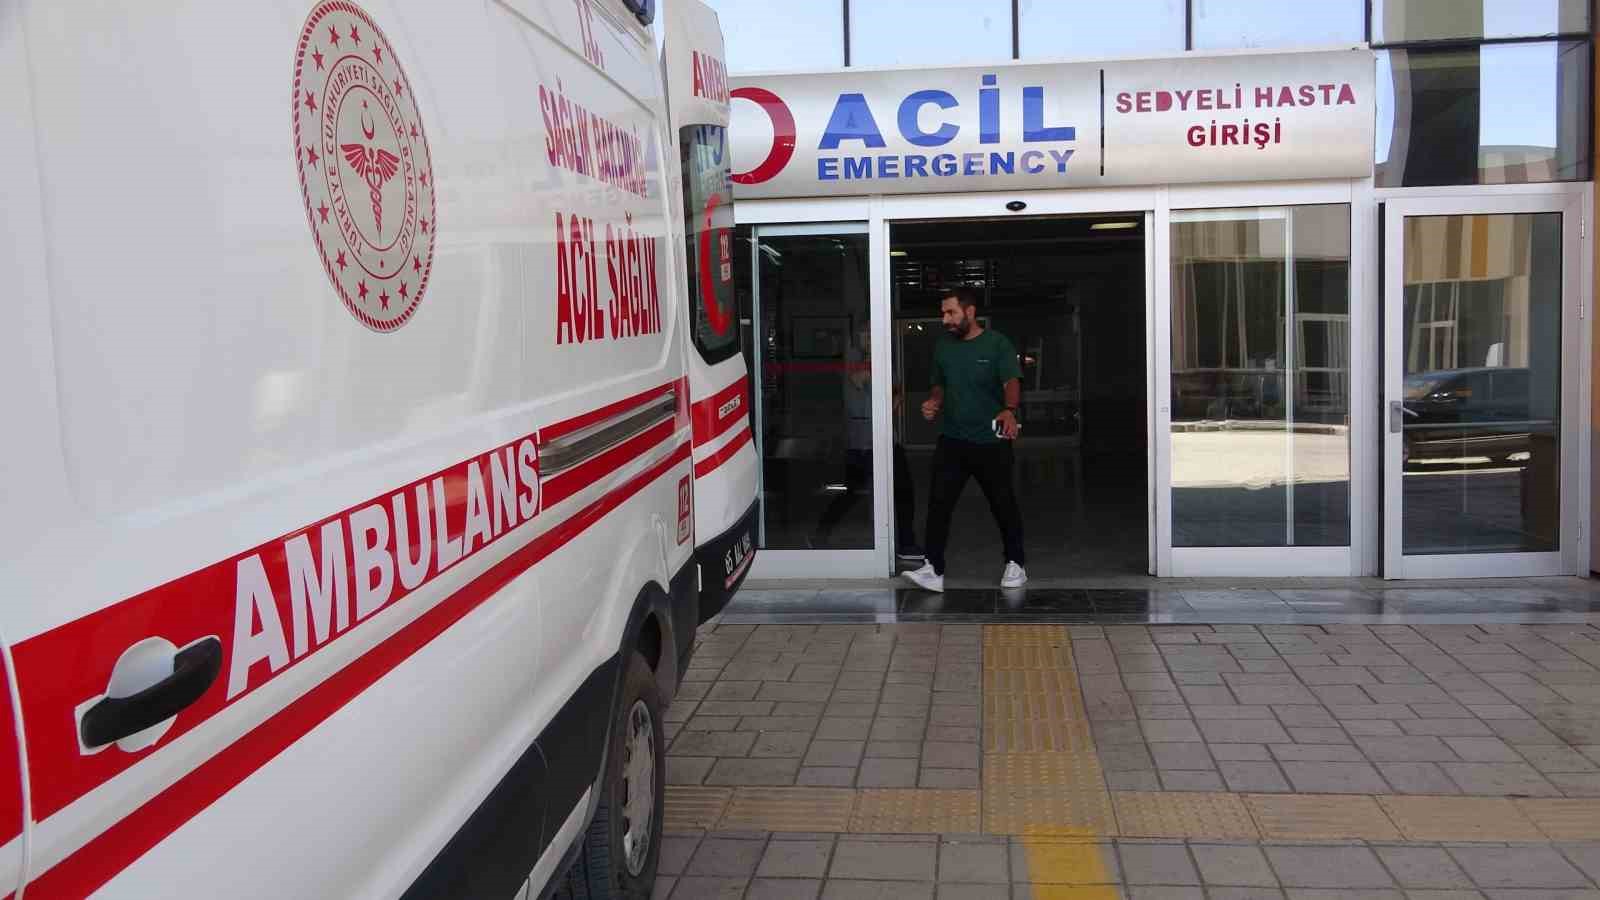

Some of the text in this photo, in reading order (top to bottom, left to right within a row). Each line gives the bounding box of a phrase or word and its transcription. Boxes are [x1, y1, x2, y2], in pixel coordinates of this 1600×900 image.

[538, 73, 595, 178] SAĞLIK
[818, 74, 1076, 149] ACİL
[1116, 83, 1356, 113] SEDYELİ HASTA
[1187, 117, 1281, 150] GİRİŞİ
[817, 149, 1075, 180] EMERGENCY
[556, 208, 661, 345] ACİL SAĞLIK
[226, 438, 539, 702] AMBULANS
